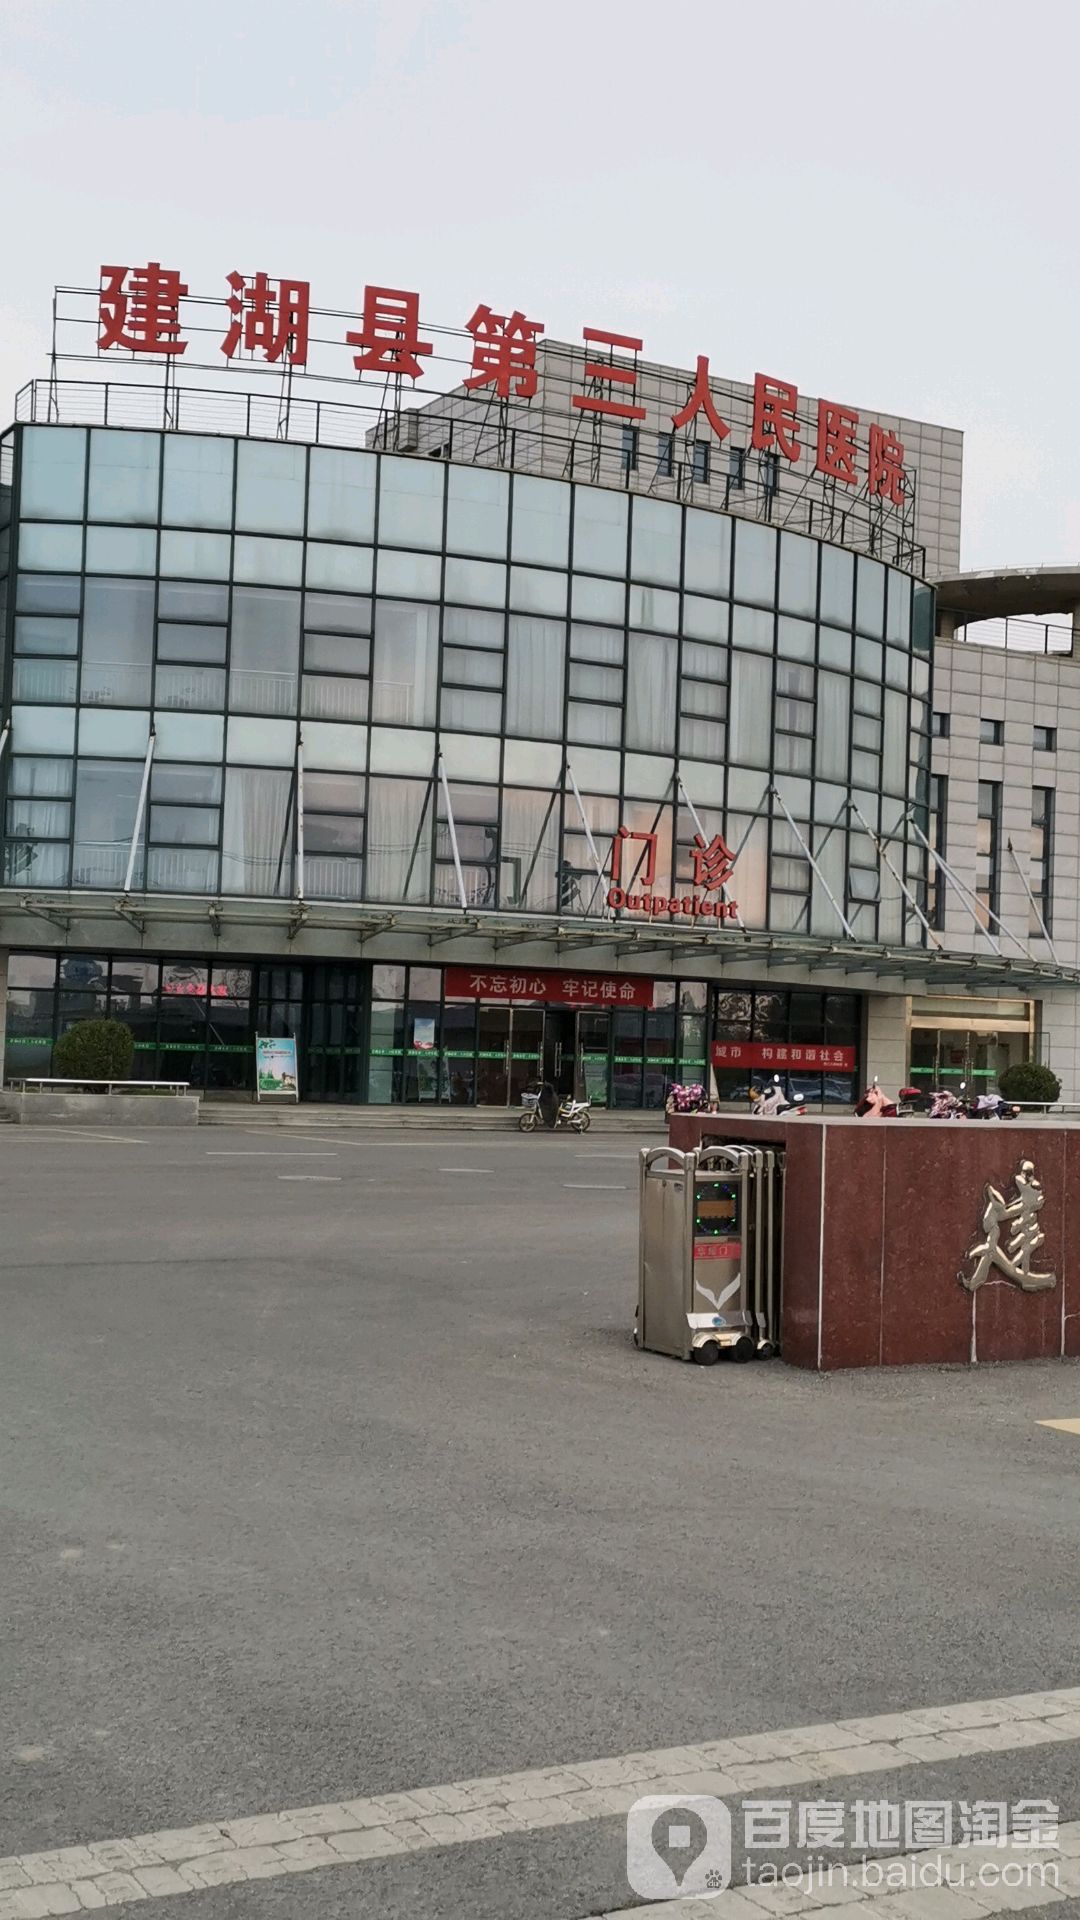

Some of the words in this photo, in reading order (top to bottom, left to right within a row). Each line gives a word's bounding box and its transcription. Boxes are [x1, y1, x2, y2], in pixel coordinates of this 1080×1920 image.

[97, 262, 905, 505] 建湖县第三人民医院
[611, 825, 736, 890] 门诊
[607, 887, 738, 919] Outpatient
[469, 974, 547, 995] 不忘初心
[562, 979, 636, 1000] 牢记使命
[762, 1047, 844, 1062] 构建和谐社会
